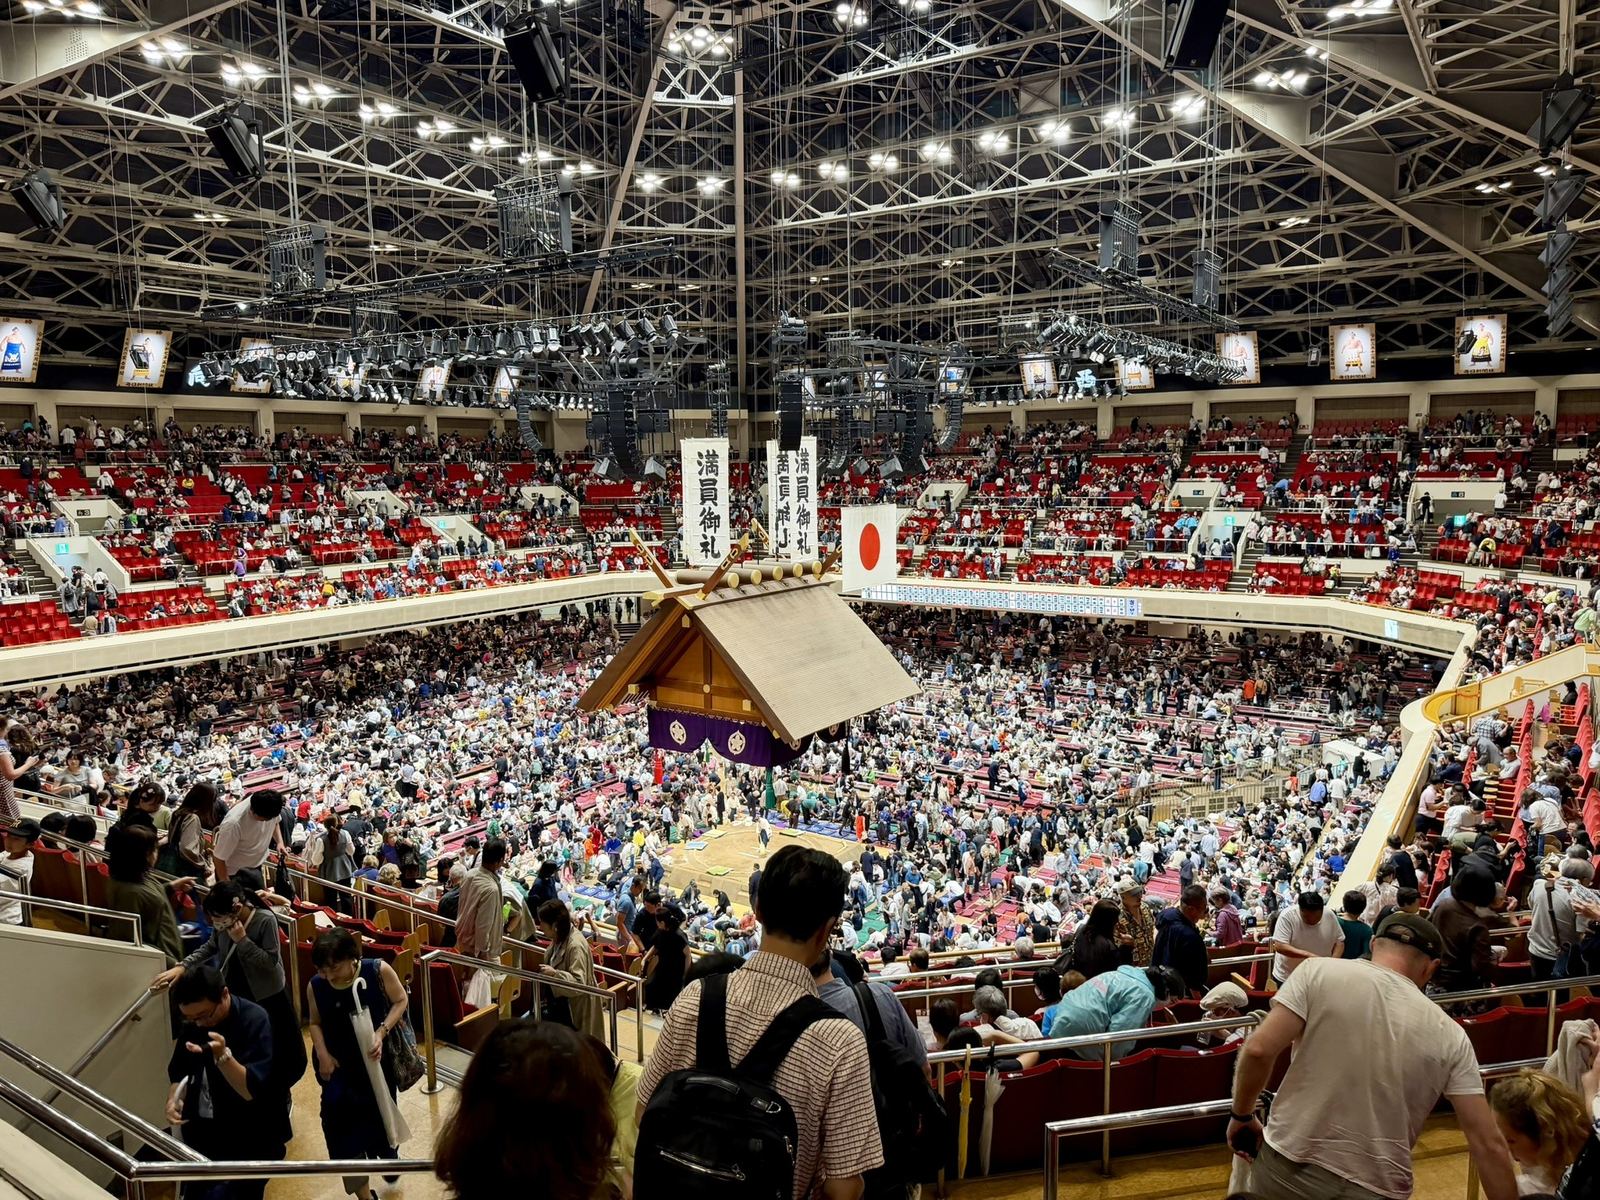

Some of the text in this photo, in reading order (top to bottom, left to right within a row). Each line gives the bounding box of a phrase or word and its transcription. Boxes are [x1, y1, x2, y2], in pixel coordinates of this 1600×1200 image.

[697, 449, 721, 559] 満員御礼
[795, 447, 811, 555] 満員御礼
